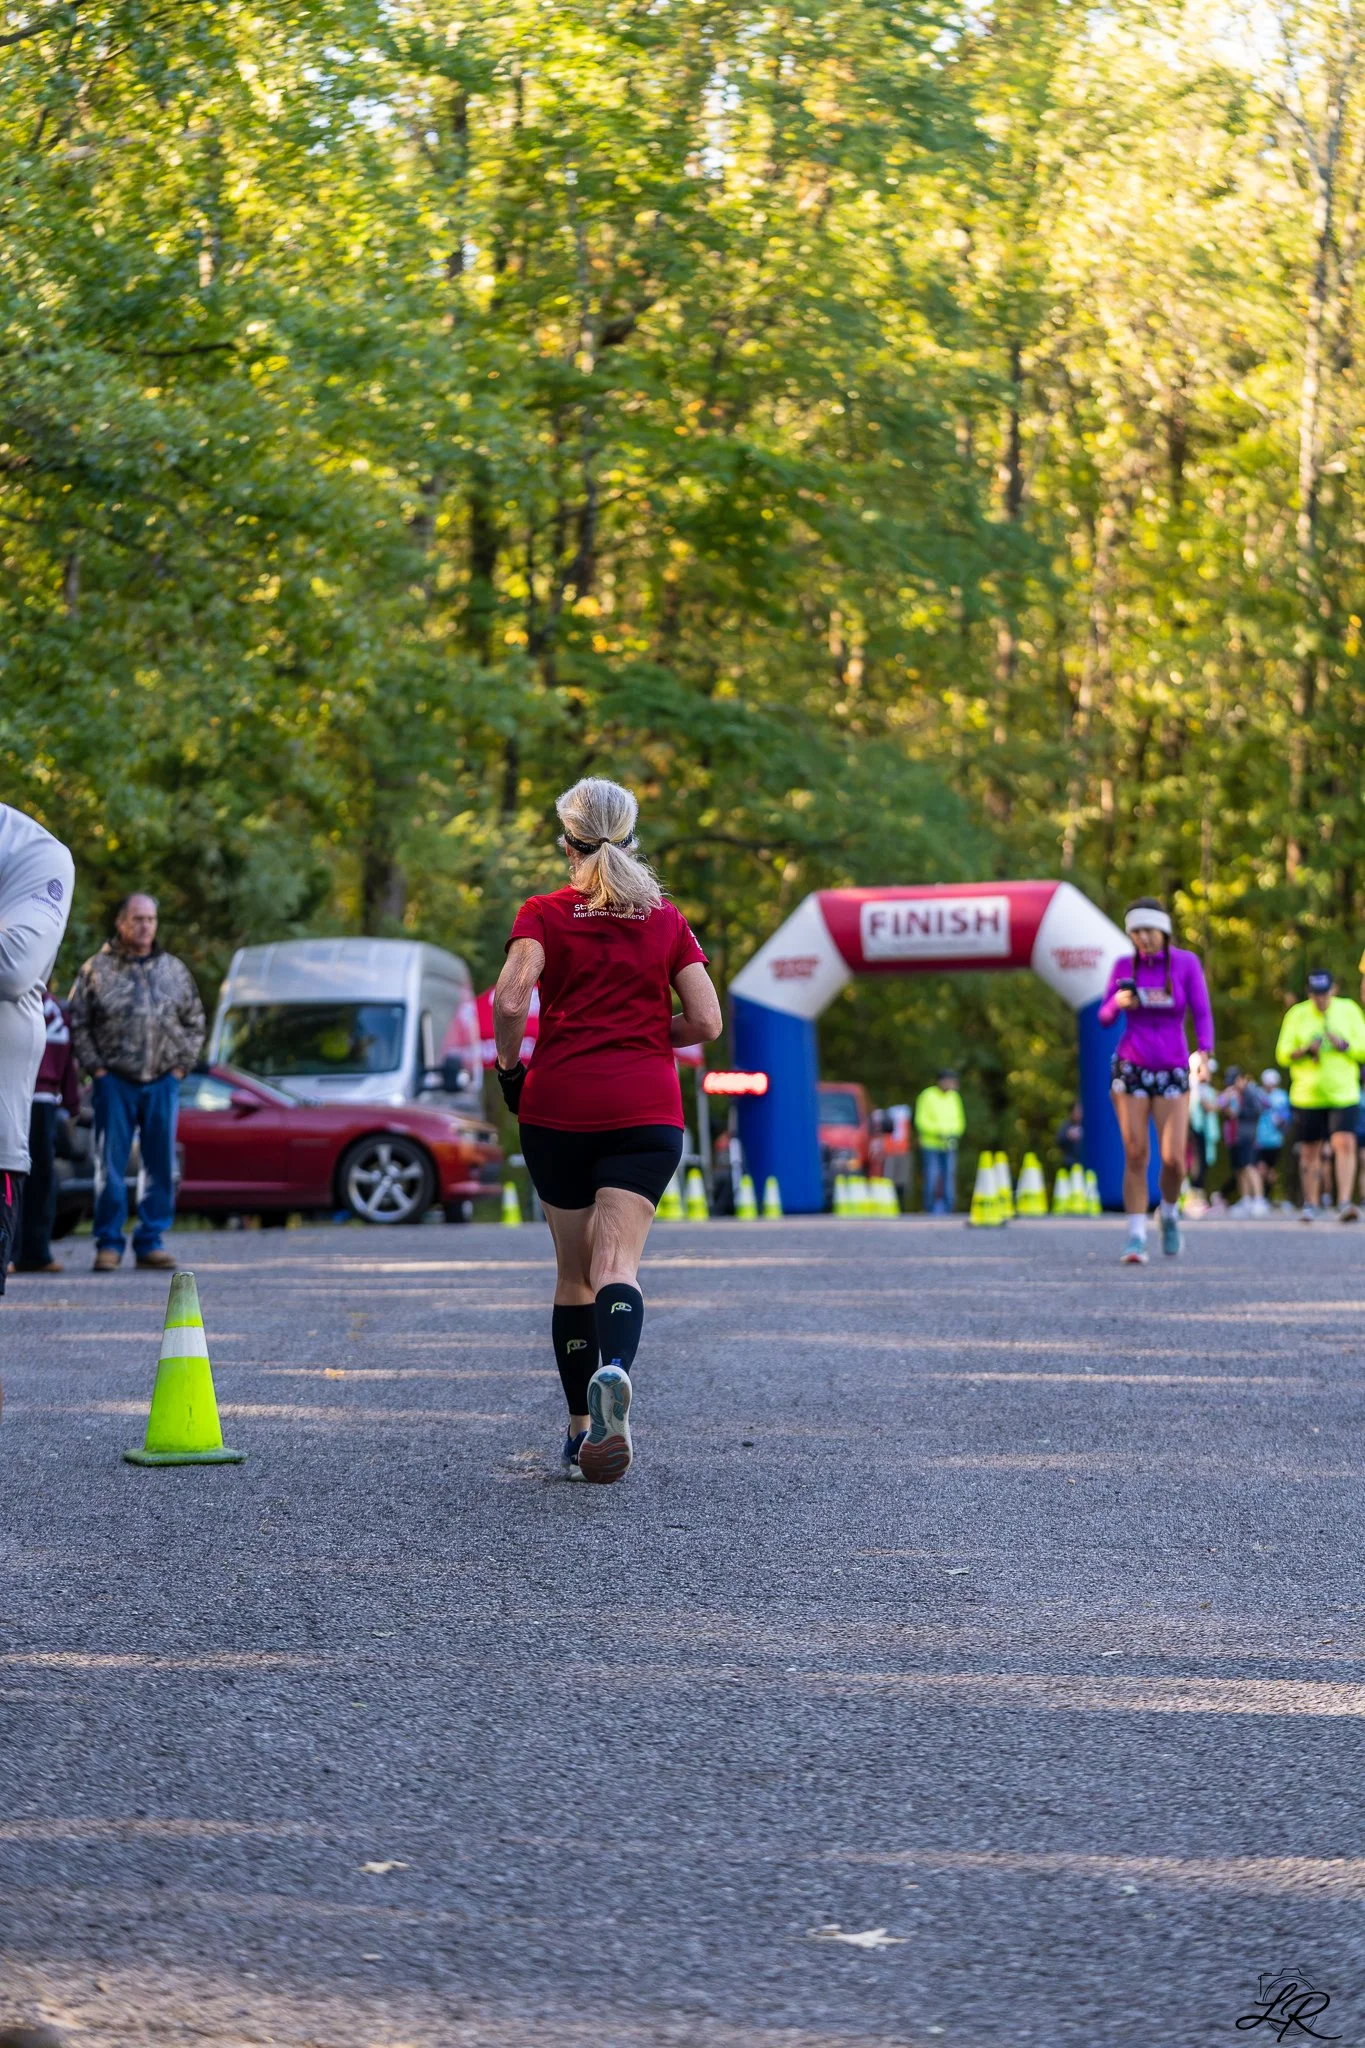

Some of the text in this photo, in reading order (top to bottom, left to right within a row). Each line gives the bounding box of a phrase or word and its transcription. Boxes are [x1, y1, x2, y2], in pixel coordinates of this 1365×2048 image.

[574, 903, 586, 911] St.
[573, 910, 610, 918] Marathon
[870, 907, 999, 936] FINISH
